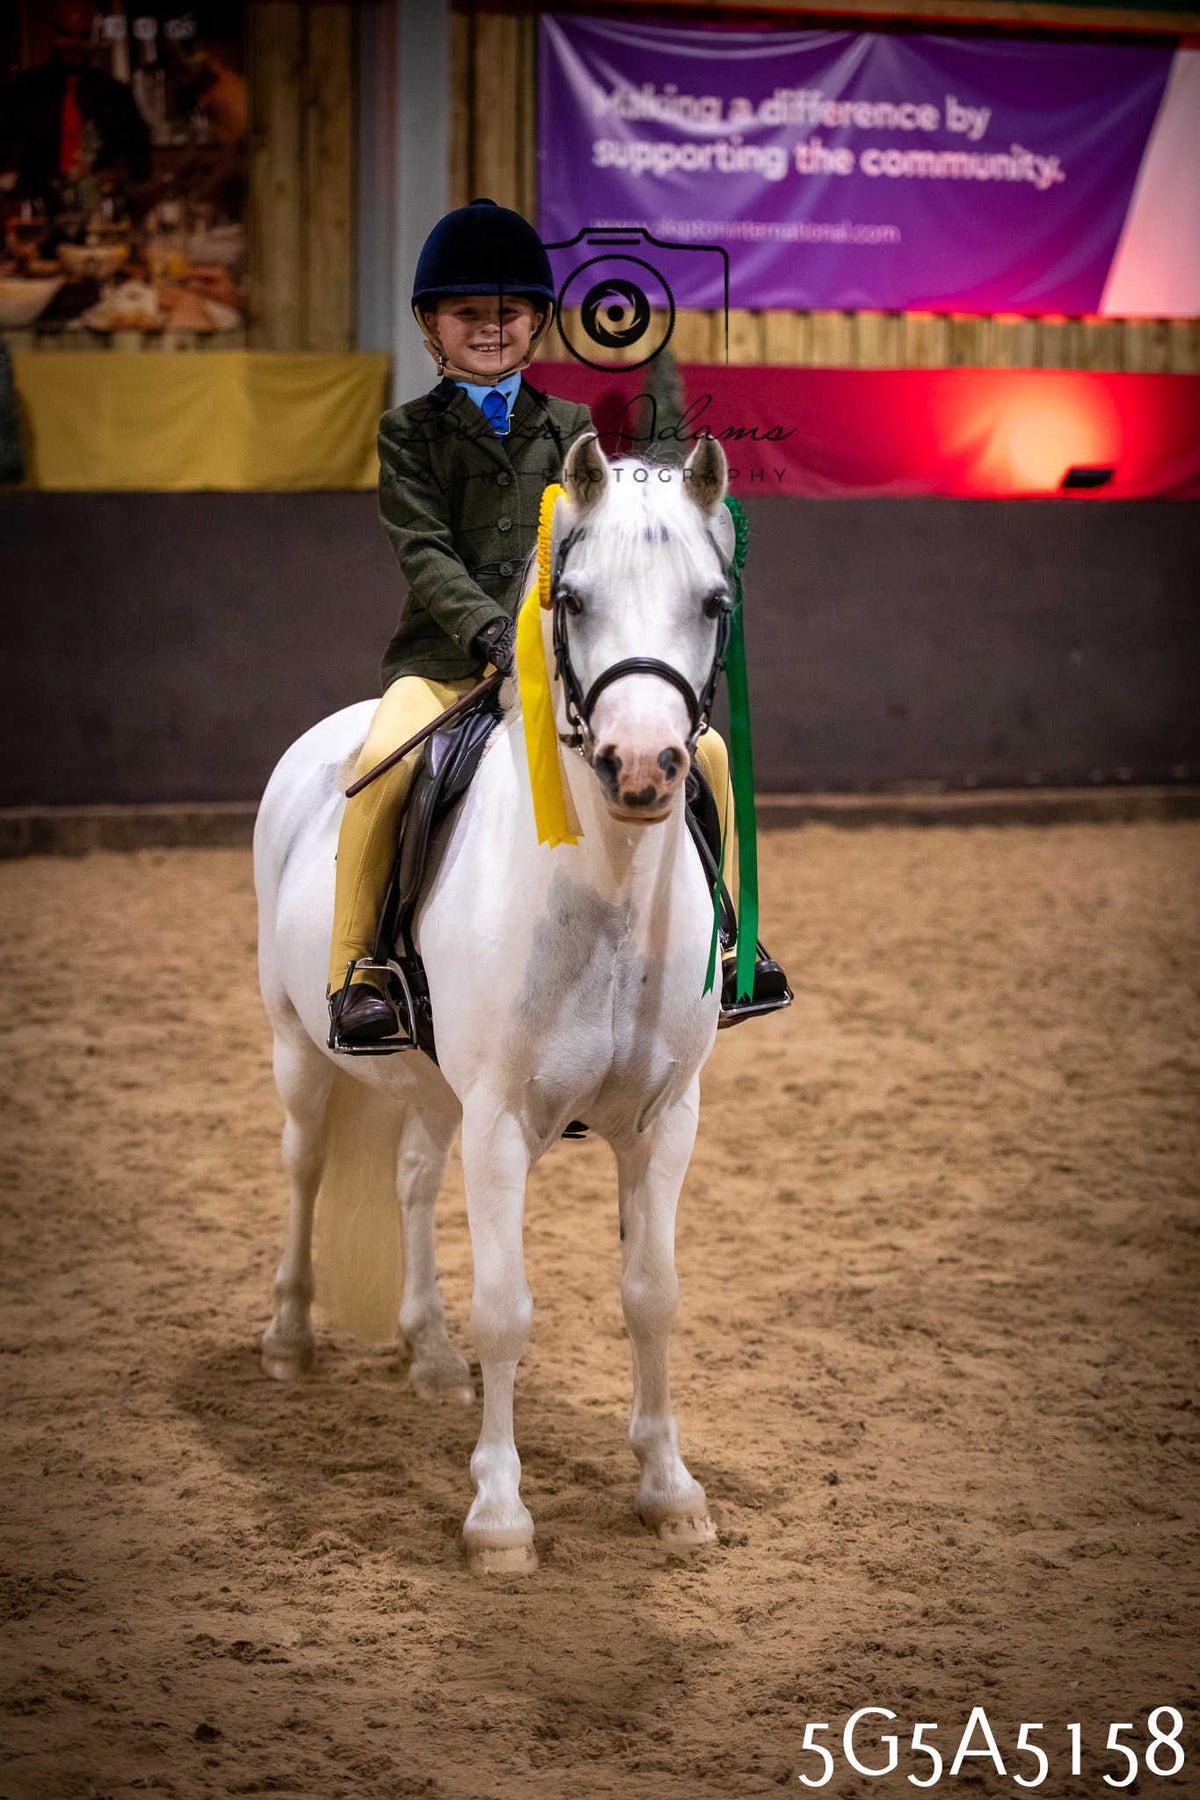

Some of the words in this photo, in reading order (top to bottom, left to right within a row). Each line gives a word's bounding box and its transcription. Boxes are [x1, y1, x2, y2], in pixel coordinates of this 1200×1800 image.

[757, 88, 940, 131] difference
[945, 95, 993, 141] by
[592, 136, 790, 180] supporting
[795, 138, 855, 175] the
[859, 143, 1066, 191] community.
